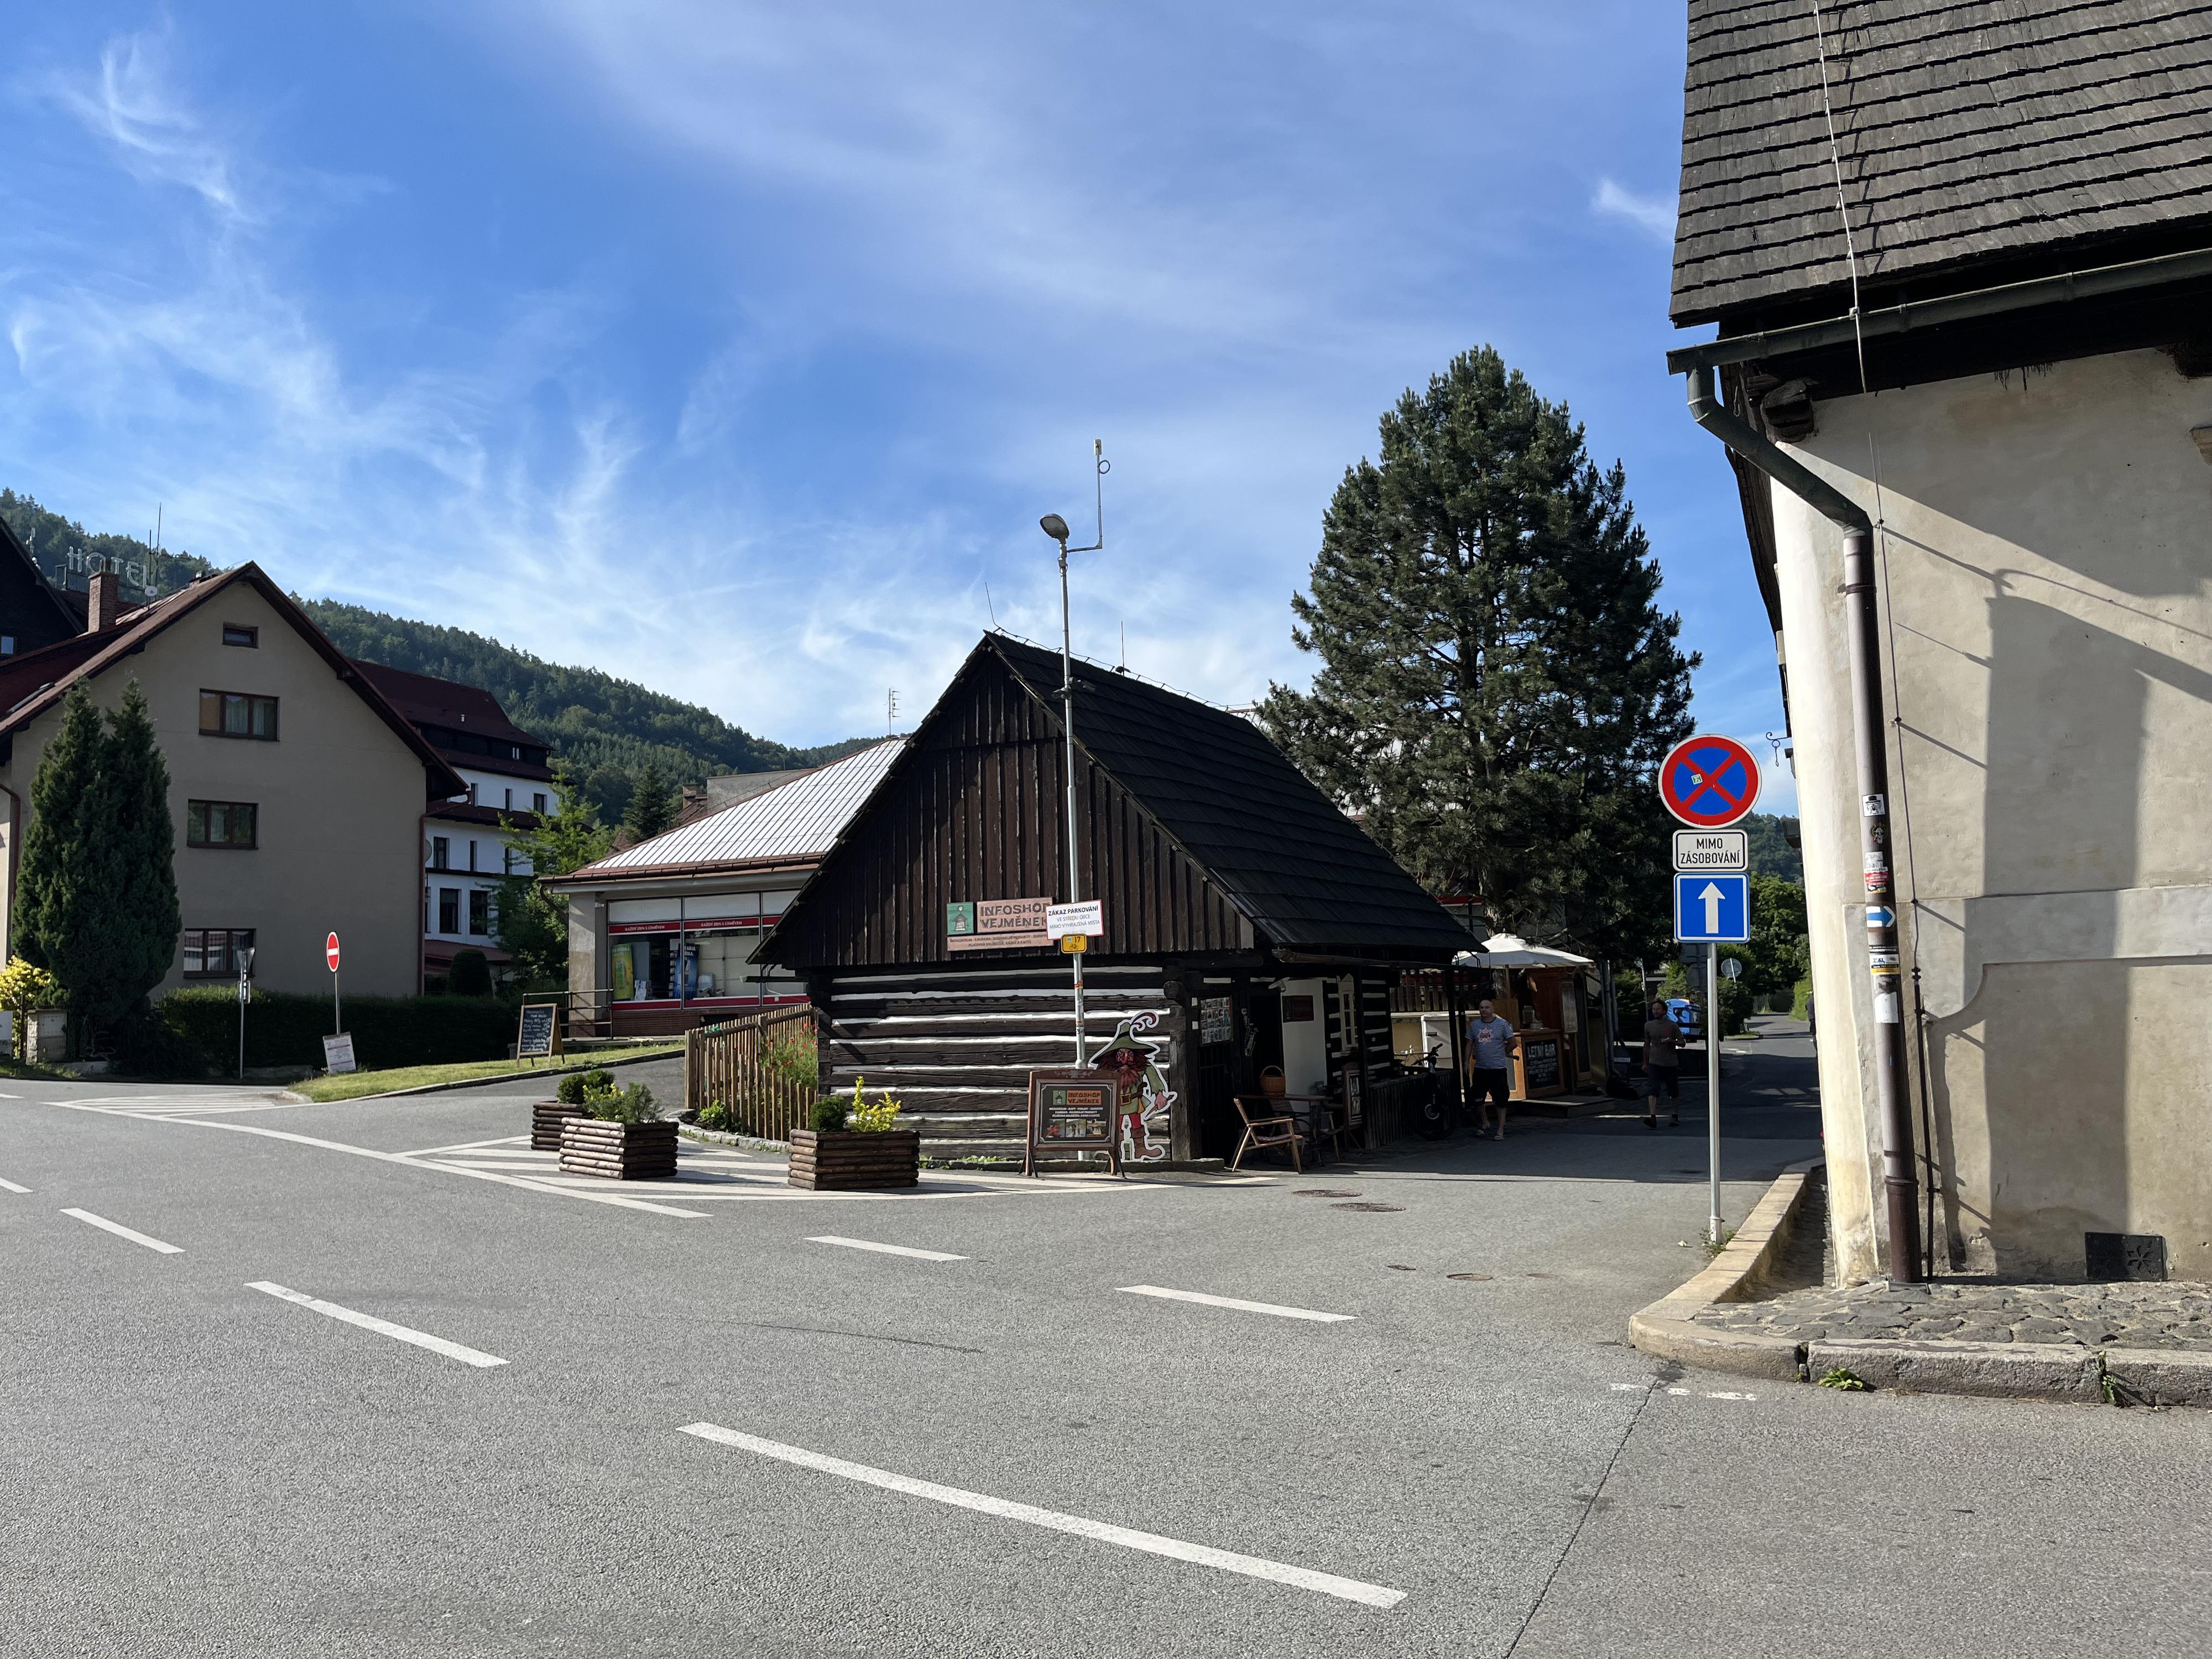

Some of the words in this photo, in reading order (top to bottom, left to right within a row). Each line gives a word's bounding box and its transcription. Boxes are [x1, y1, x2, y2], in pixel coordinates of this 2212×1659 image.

[67, 546, 148, 589] HOTEL
[1696, 838, 1723, 849] MIMO
[1680, 849, 1740, 864] ZÁSOBOVÁNÍ
[1067, 905, 1098, 914] PARKOVÁNÍ
[1544, 1044, 1556, 1057] BAR
